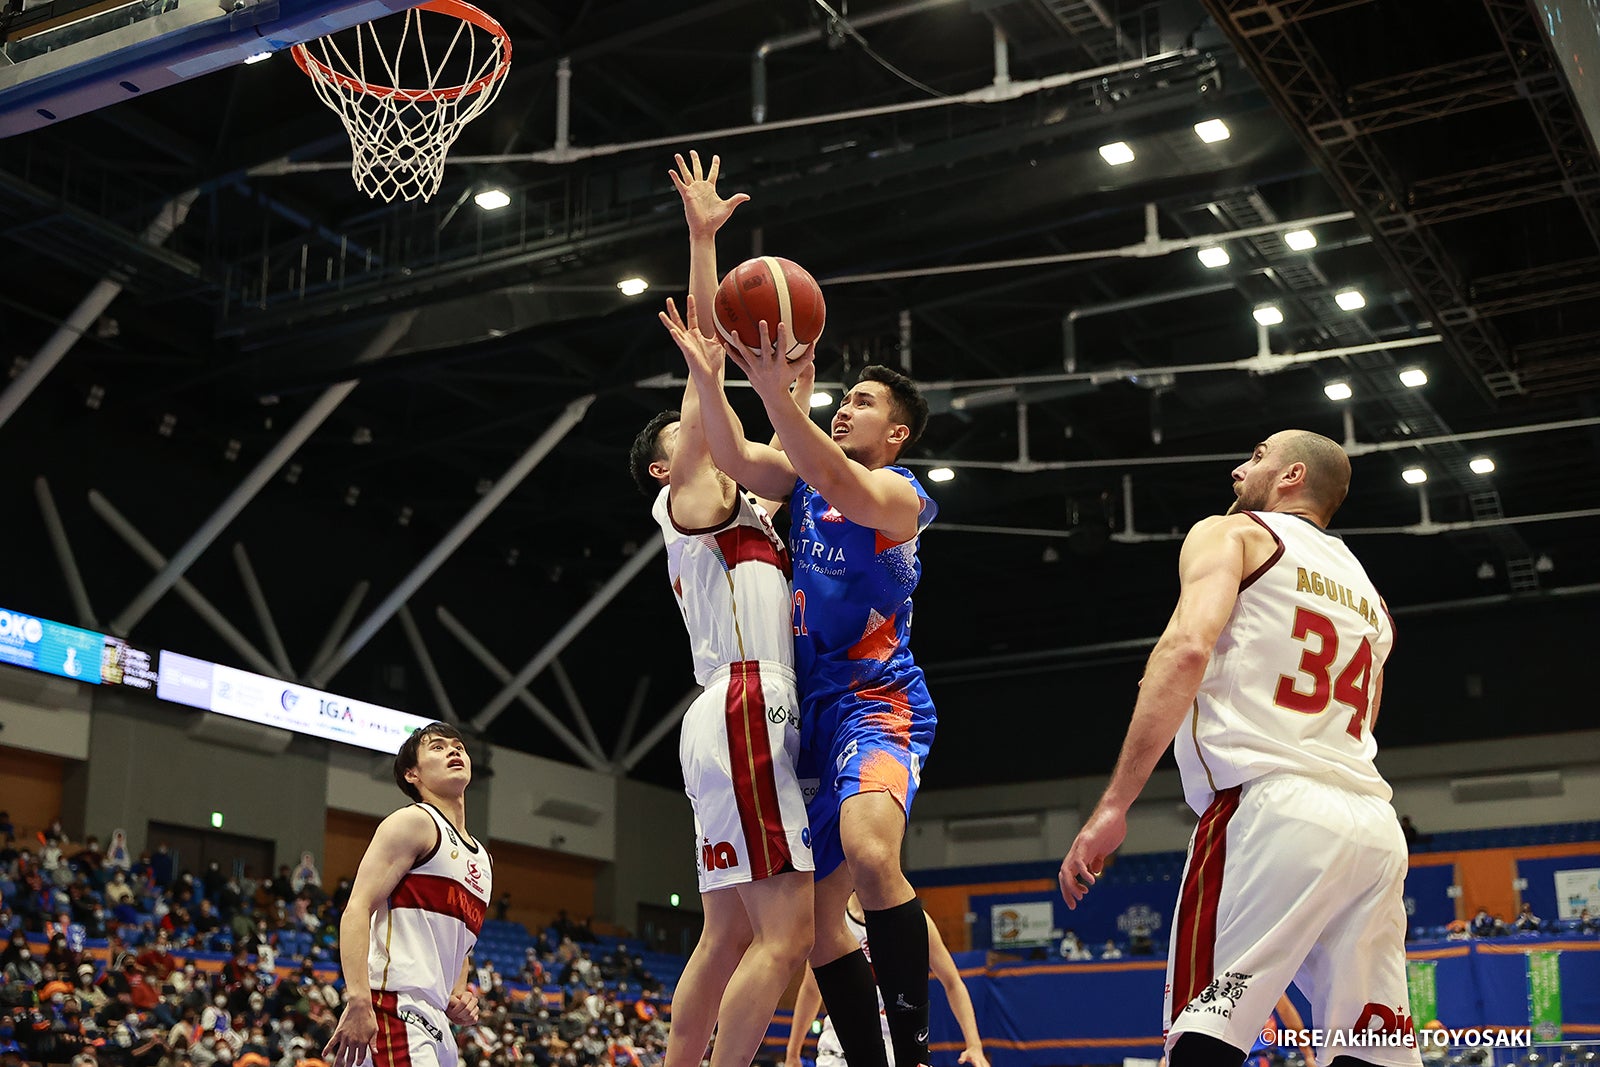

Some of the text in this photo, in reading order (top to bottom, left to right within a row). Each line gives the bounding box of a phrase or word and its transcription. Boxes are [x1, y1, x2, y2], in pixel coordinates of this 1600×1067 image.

[811, 562, 846, 576] fashion!
[792, 589, 808, 636] 2
[1296, 567, 1380, 632] AGUILAR
[1273, 605, 1373, 743] 34
[319, 699, 354, 722] IGA
[702, 837, 739, 872] ia
